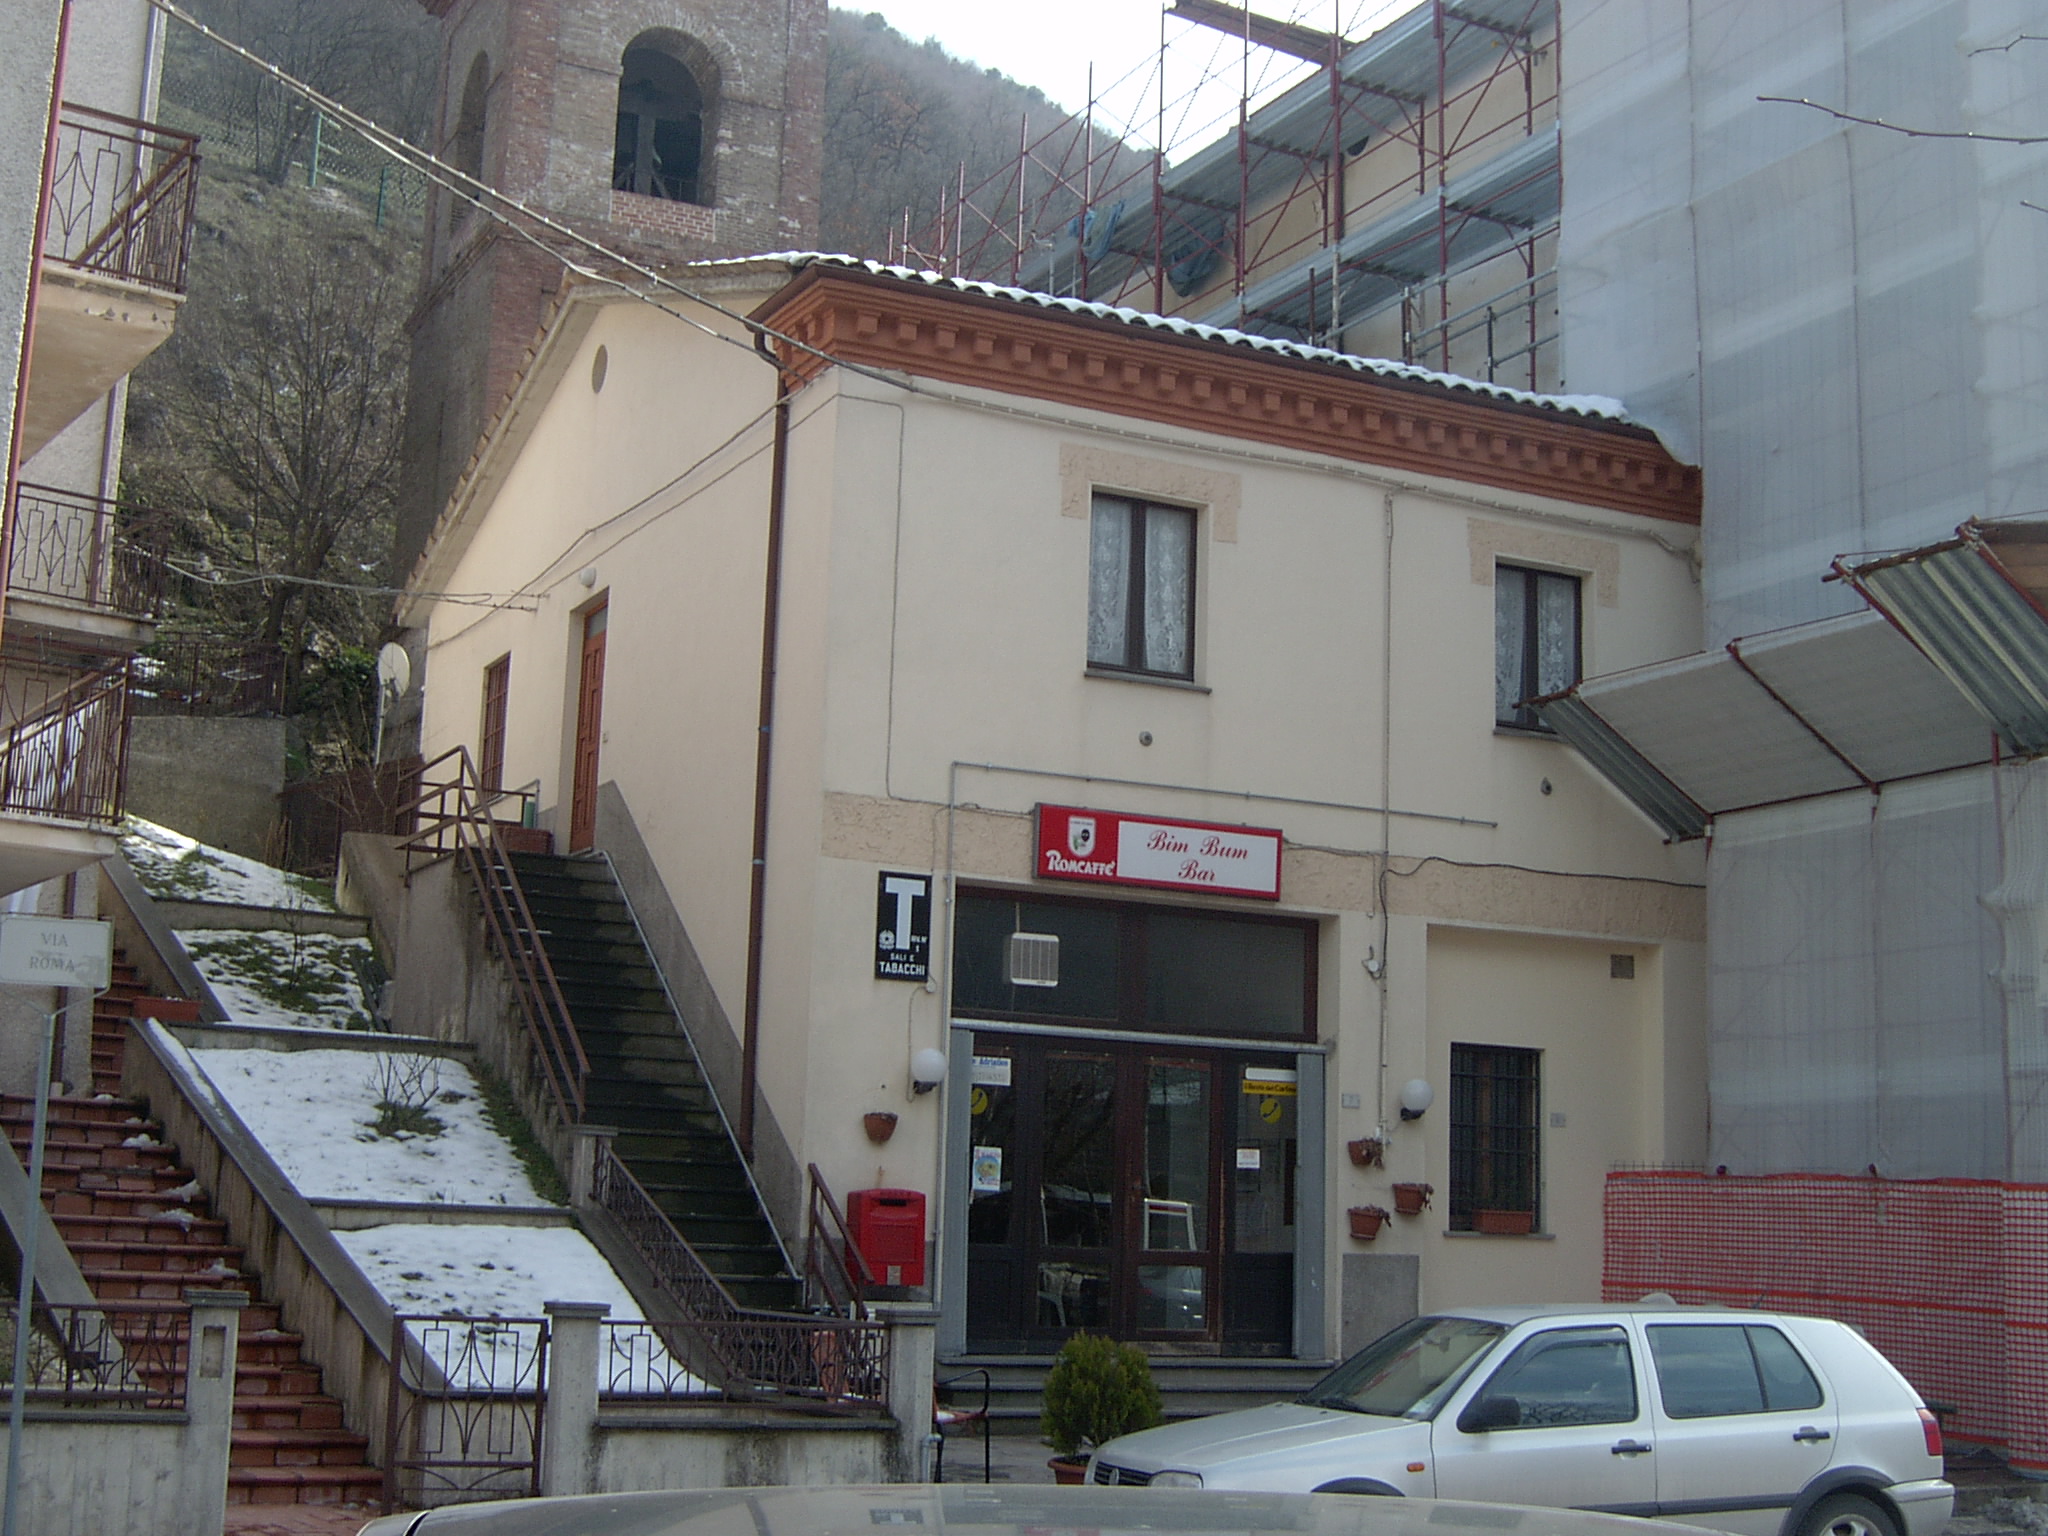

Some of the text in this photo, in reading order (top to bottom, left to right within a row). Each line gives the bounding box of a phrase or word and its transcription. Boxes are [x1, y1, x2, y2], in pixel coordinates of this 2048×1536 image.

[1147, 830, 1248, 860] Bim Bum
[1178, 859, 1216, 882] Bar
[885, 876, 926, 950] T
[41, 932, 68, 947] VIA
[30, 956, 75, 973] ROMA
[880, 961, 926, 976] TABACCHI
